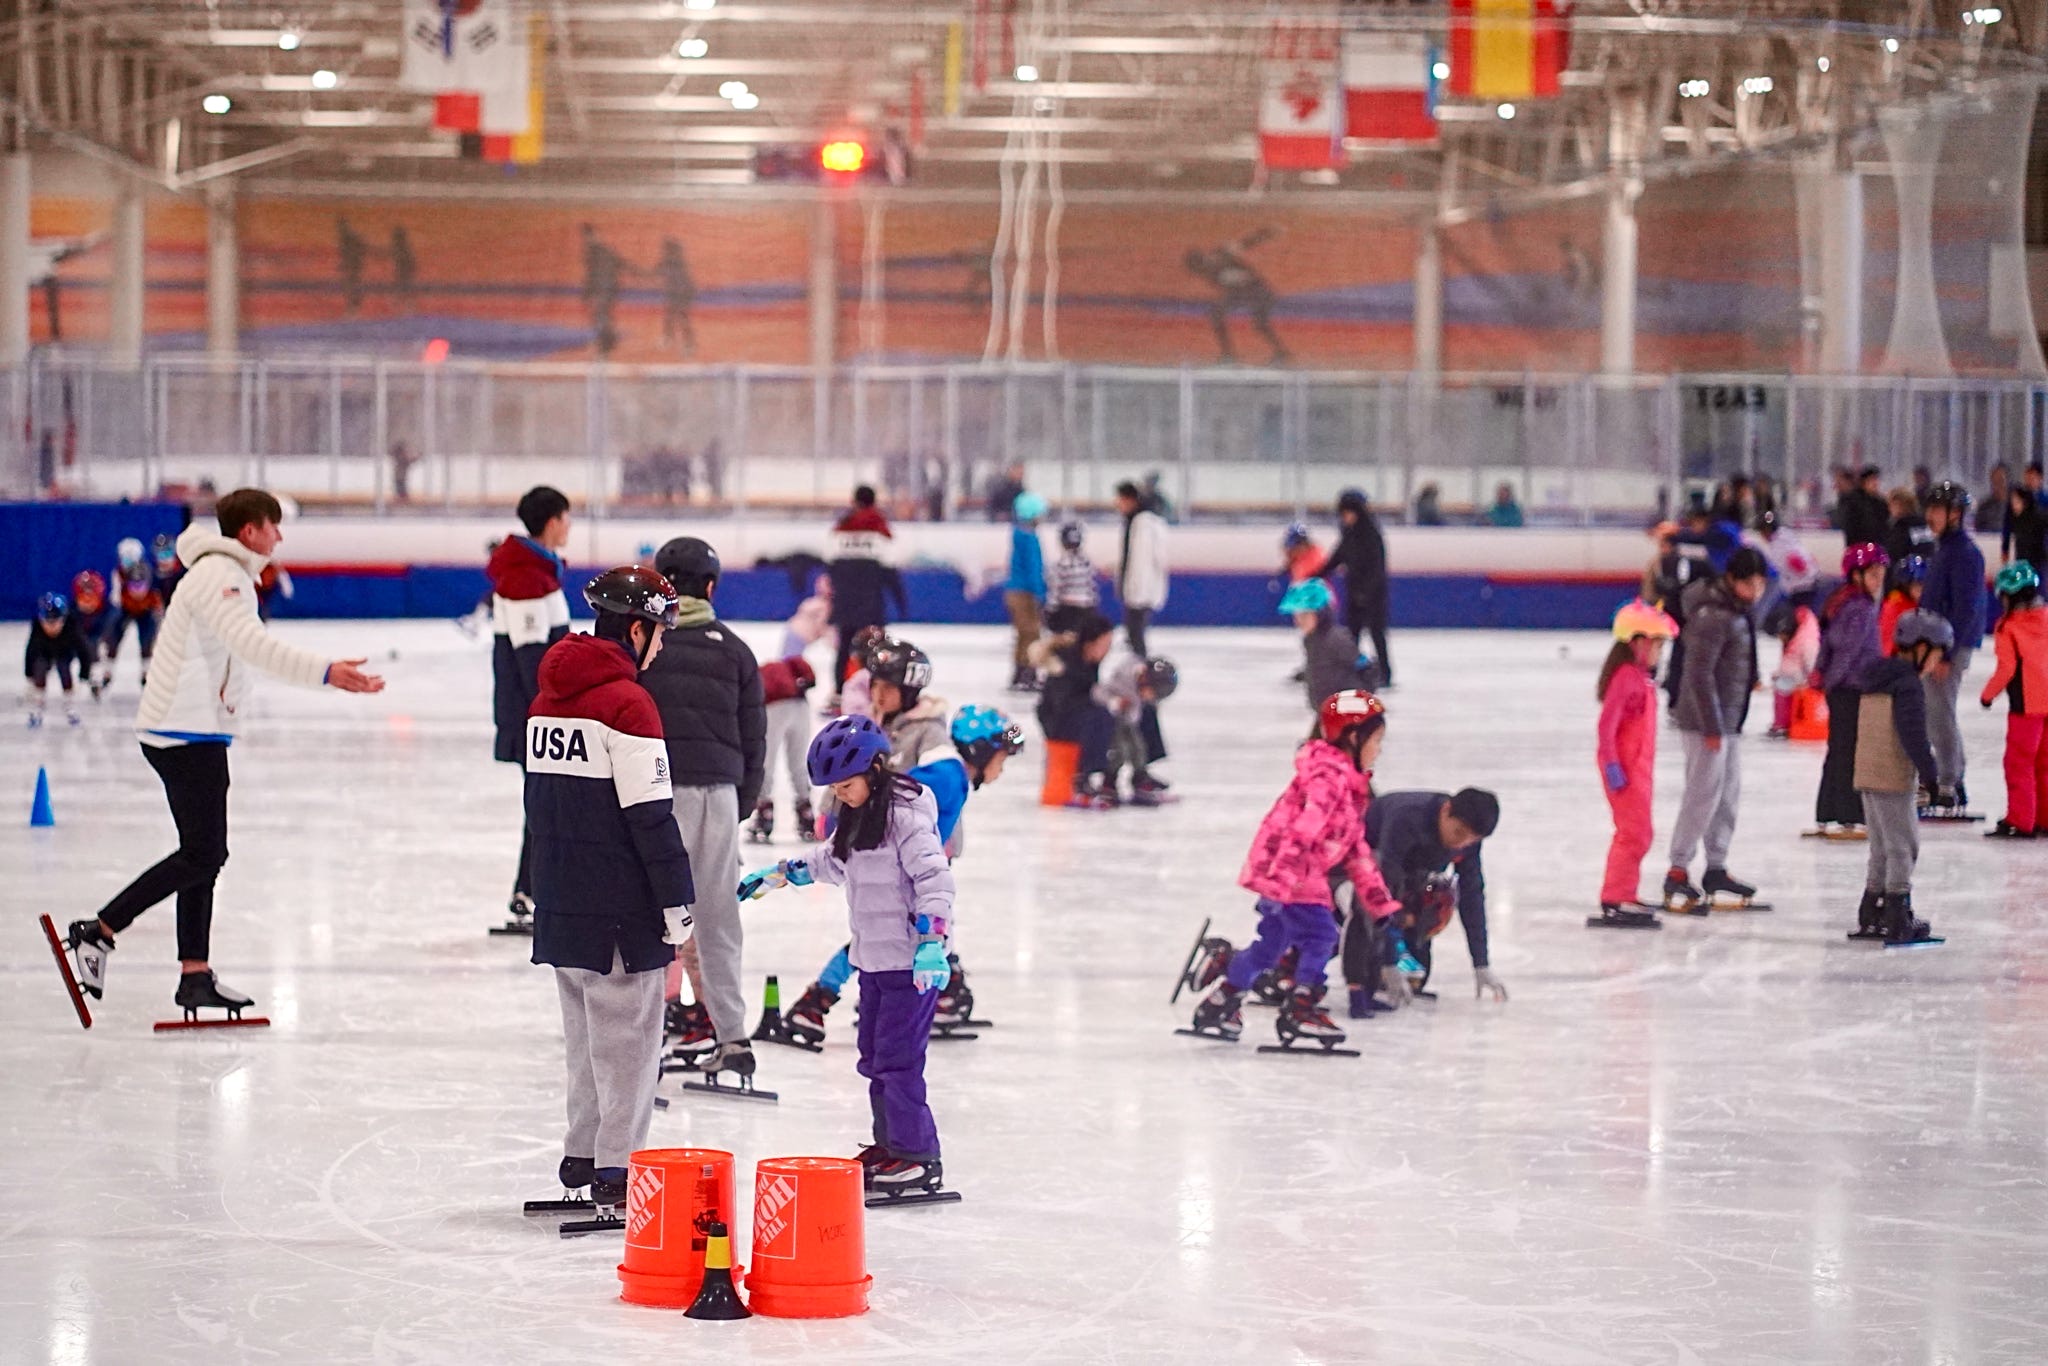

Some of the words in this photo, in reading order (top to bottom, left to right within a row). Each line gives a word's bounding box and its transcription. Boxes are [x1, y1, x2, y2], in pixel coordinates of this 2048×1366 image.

[532, 726, 589, 762] USA
[625, 1168, 664, 1228] HO
[753, 1176, 796, 1240] HO
[760, 1216, 788, 1247] THE
